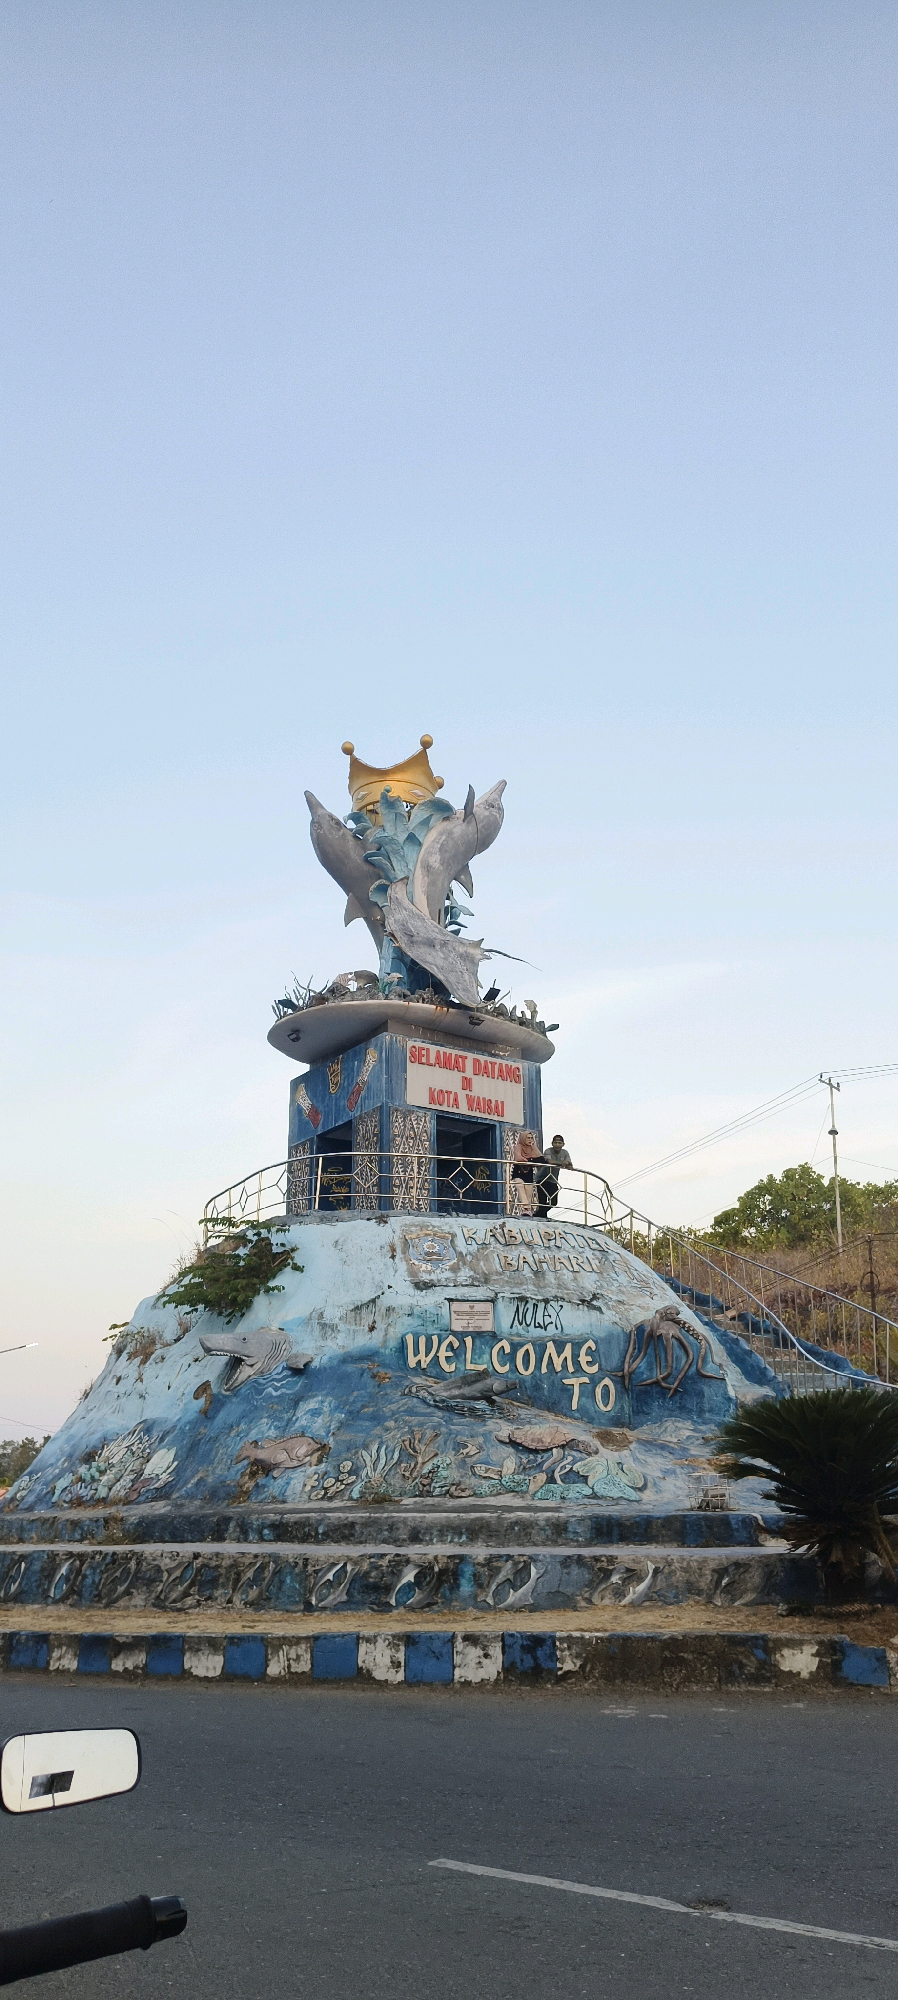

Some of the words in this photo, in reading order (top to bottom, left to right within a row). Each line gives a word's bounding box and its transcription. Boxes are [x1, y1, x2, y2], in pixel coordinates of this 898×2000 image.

[408, 1045, 468, 1074] SELAMAT
[472, 1057, 522, 1084] DATANG
[428, 1087, 460, 1110] KOTA
[465, 1094, 505, 1117] WAISAI
[461, 1076, 473, 1092] DI
[404, 1333, 599, 1376] WELCOME
[561, 1376, 616, 1412] TO
